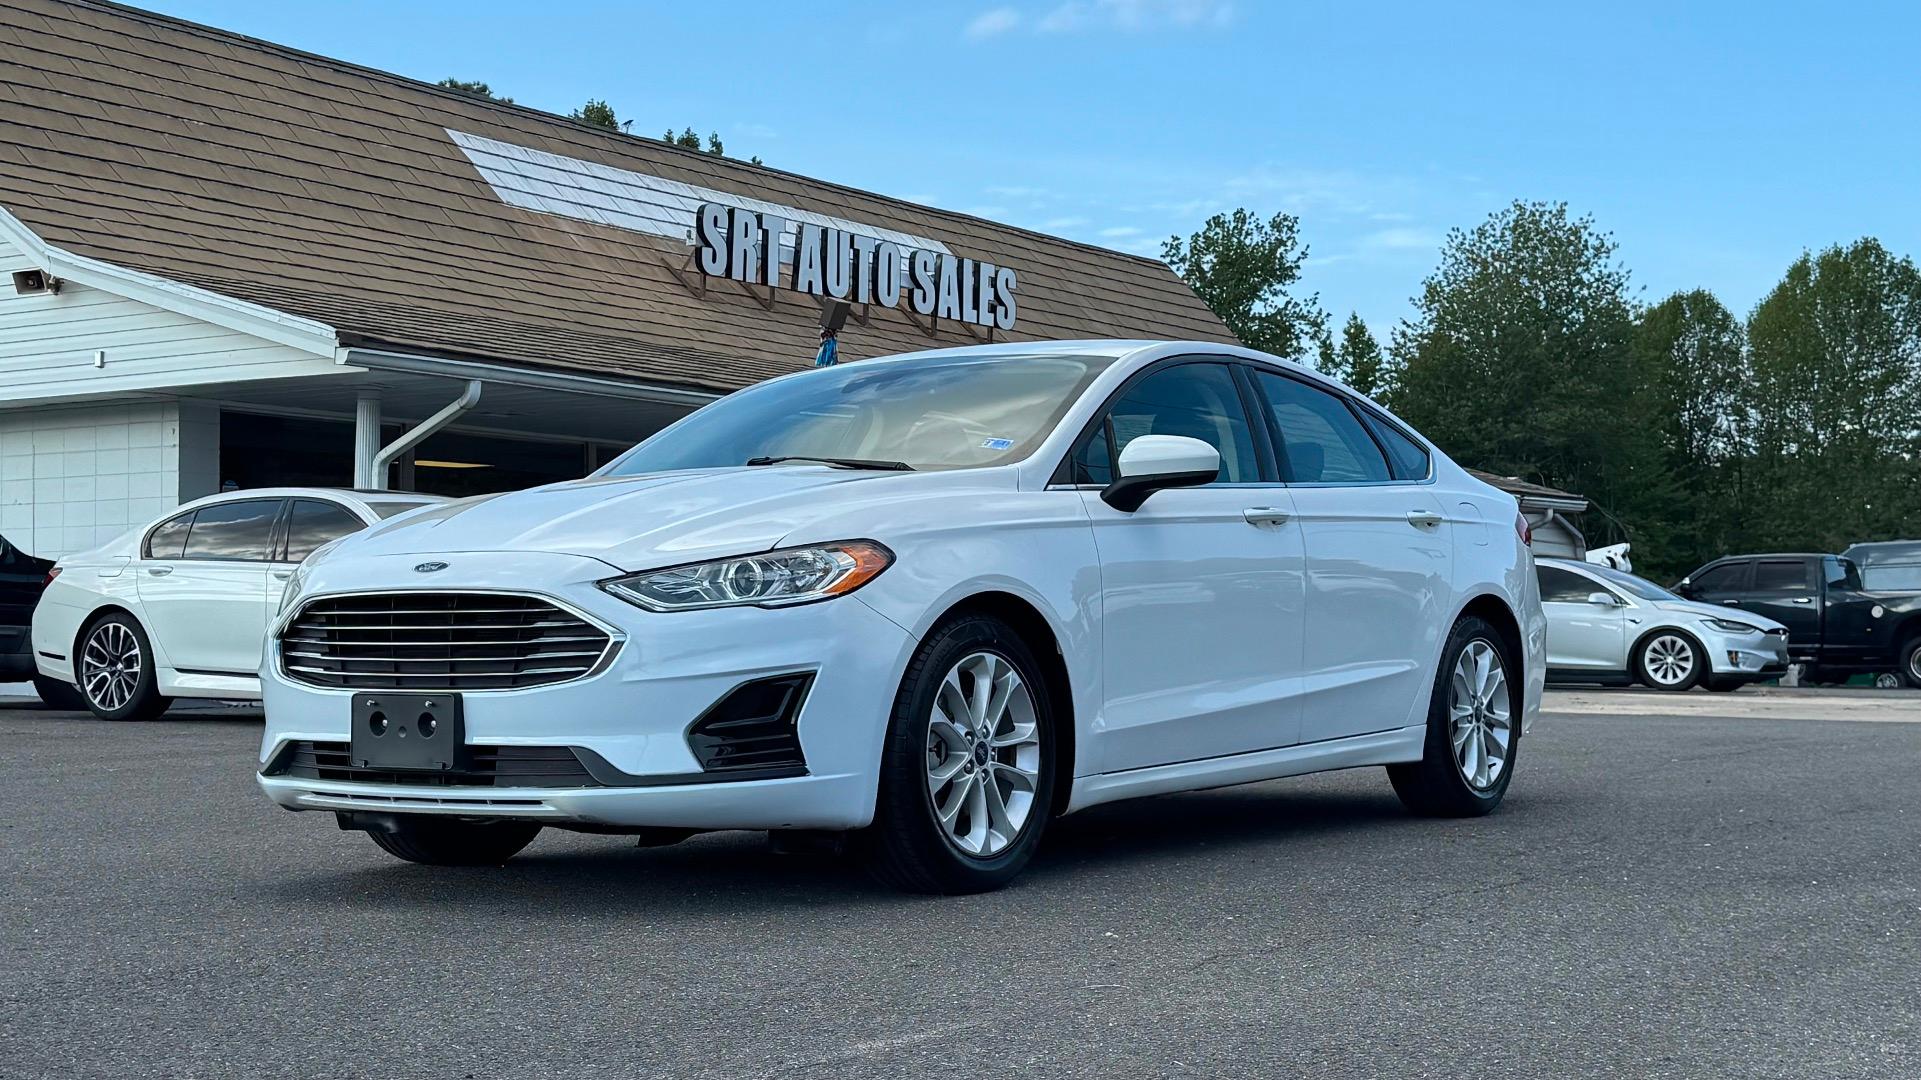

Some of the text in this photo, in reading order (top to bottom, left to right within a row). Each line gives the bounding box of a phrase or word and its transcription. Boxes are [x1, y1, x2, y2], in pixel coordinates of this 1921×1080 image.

[697, 203, 1016, 330] SRT AUTO SALES
